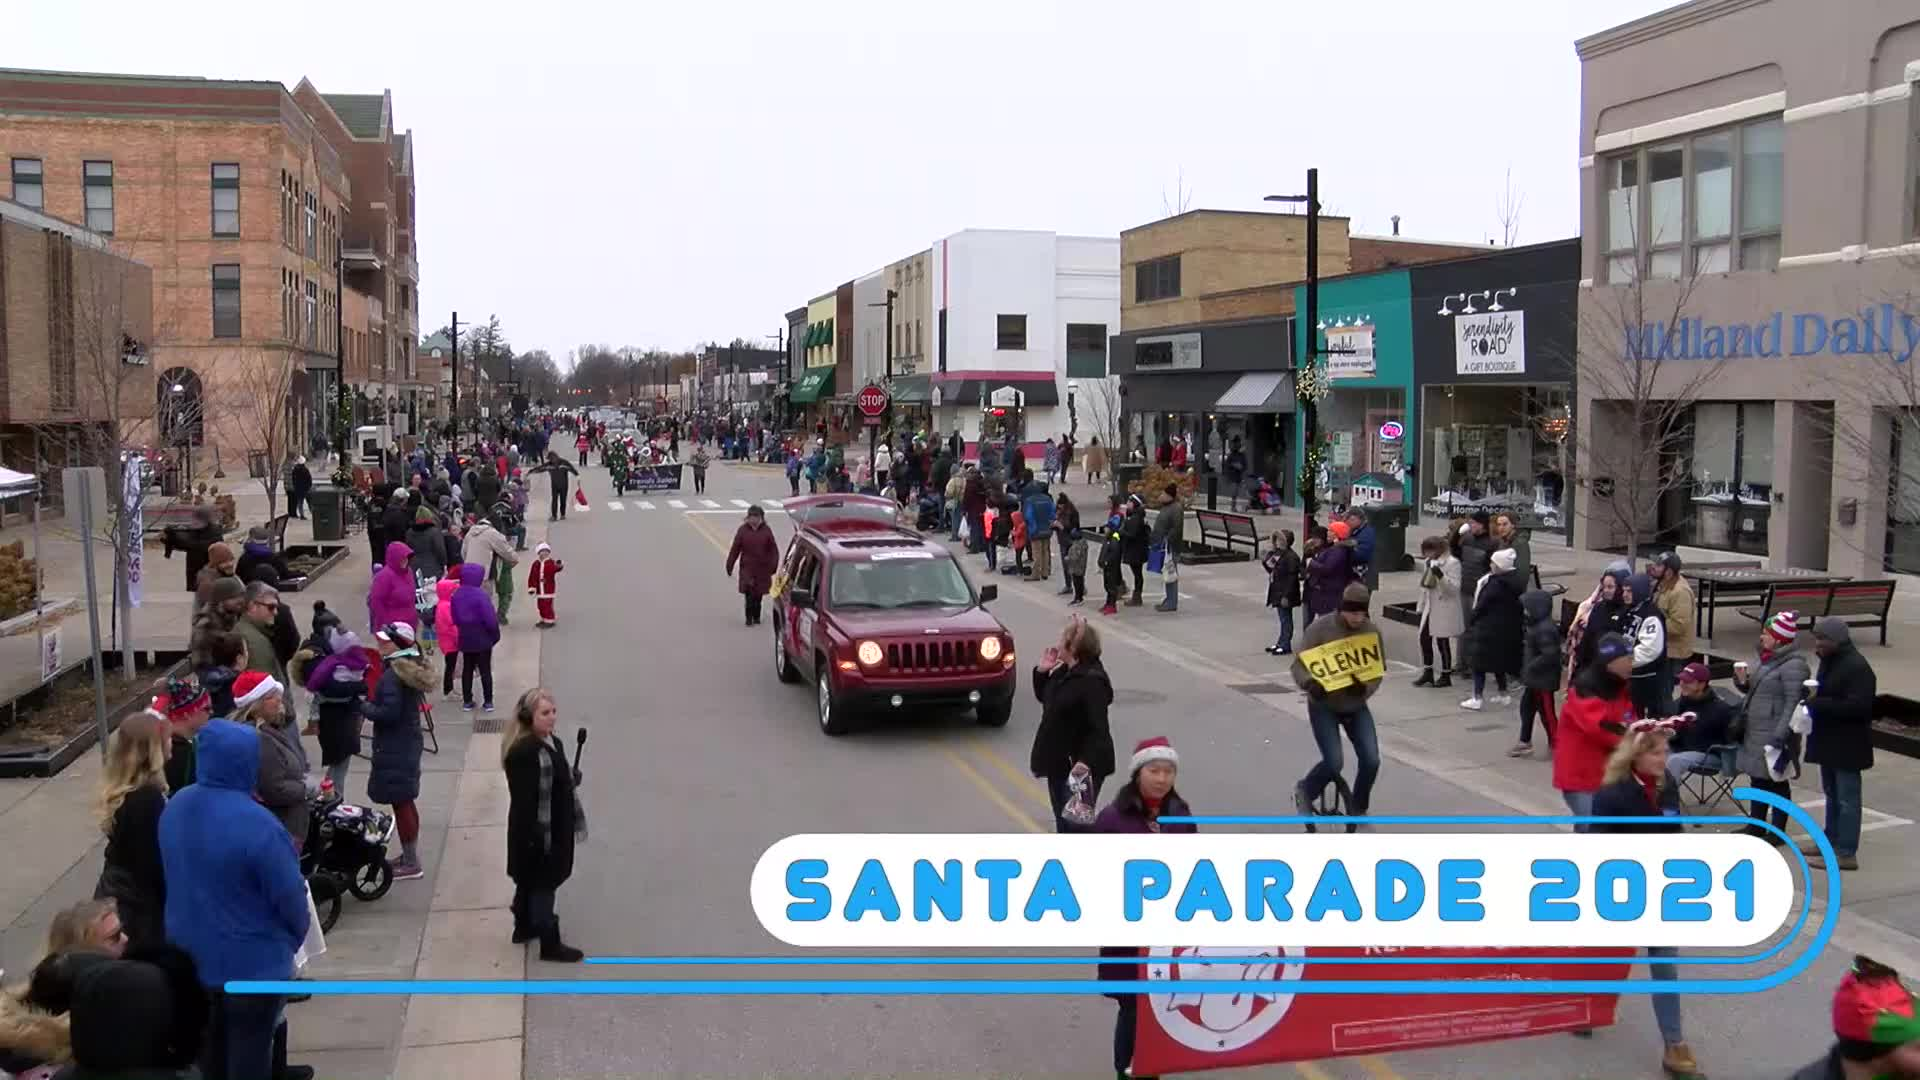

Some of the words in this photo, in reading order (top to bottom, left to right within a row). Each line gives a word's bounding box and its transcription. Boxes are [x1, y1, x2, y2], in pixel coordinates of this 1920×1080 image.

[1624, 312, 1784, 361] Midland
[1790, 304, 1920, 363] Daily
[1471, 337, 1507, 356] ROAD
[1464, 363, 1469, 372] A
[1470, 362, 1484, 372] GIFT
[1485, 360, 1516, 372] BOUTIQUE
[861, 395, 884, 406] STOP
[1453, 504, 1480, 514] Home
[1309, 644, 1380, 678] GLENN
